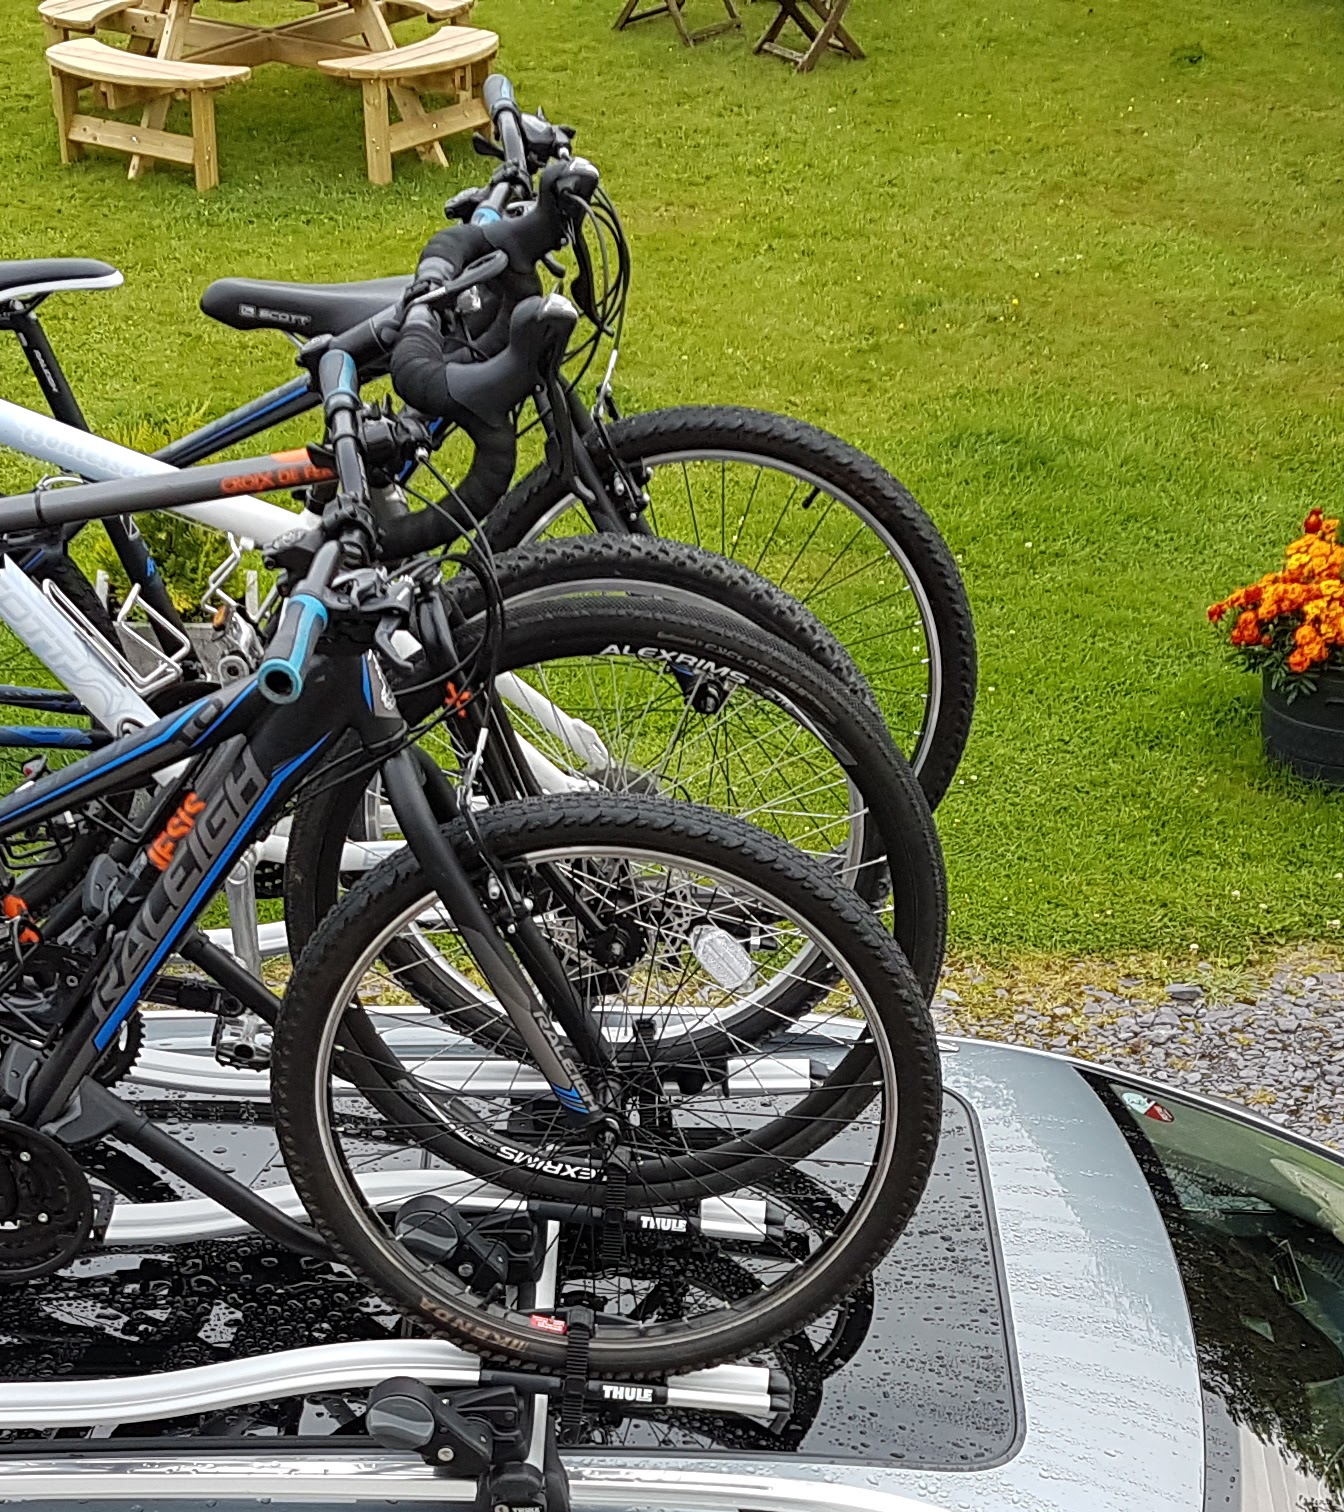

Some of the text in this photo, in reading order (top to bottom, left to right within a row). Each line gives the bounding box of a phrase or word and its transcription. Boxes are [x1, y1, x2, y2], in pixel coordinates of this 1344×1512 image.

[258, 308, 312, 326] SCOTT
[220, 471, 275, 494] CROIX
[277, 469, 300, 483] DE
[600, 643, 750, 686] ALEXRIMS
[91, 744, 269, 1021] RALEIGH
[532, 1010, 600, 1112] RALEIGH
[641, 1216, 687, 1233] THULE
[602, 1384, 653, 1403] THULE
